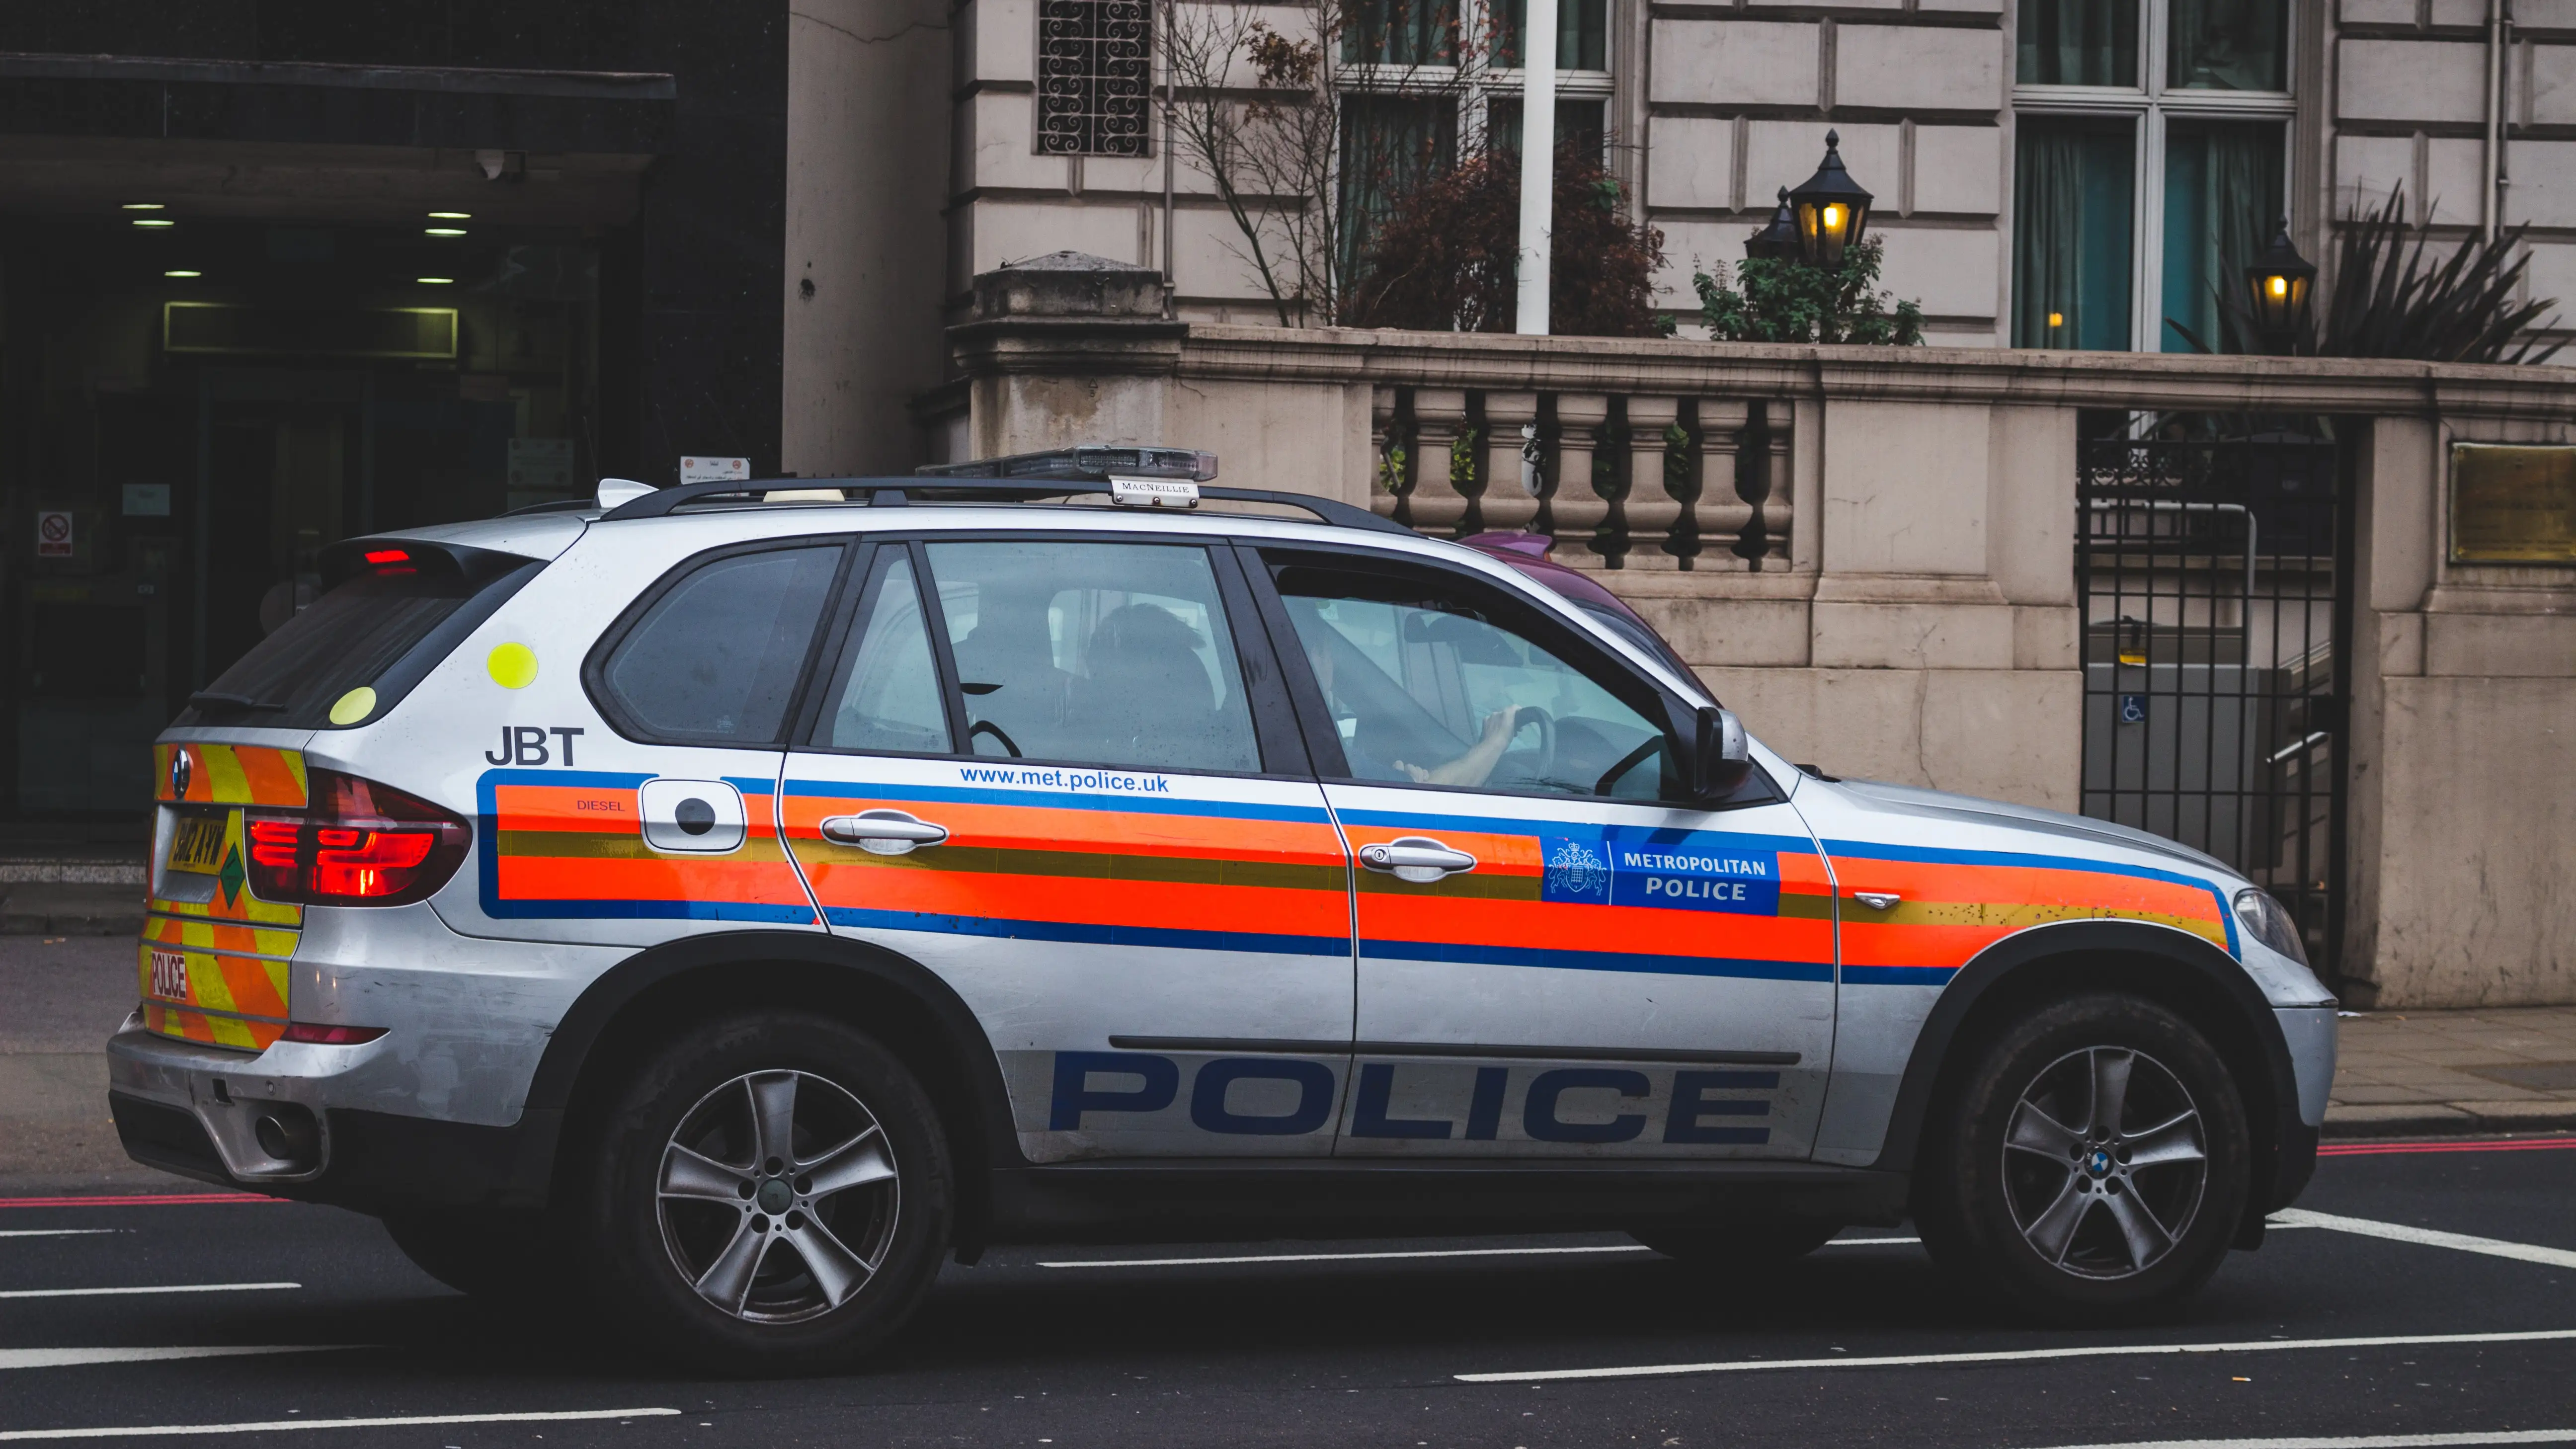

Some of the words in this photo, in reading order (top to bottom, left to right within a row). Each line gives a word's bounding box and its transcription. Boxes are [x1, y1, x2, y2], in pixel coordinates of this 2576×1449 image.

[484, 725, 584, 767] JBT
[960, 768, 1170, 793] www.met.police.uk
[576, 800, 626, 812] DIESEL
[1624, 852, 1766, 876] METROPOLITAN
[1646, 877, 1747, 901] POLICE
[152, 953, 186, 998] POLICE
[1049, 1050, 1780, 1144] POLICE
